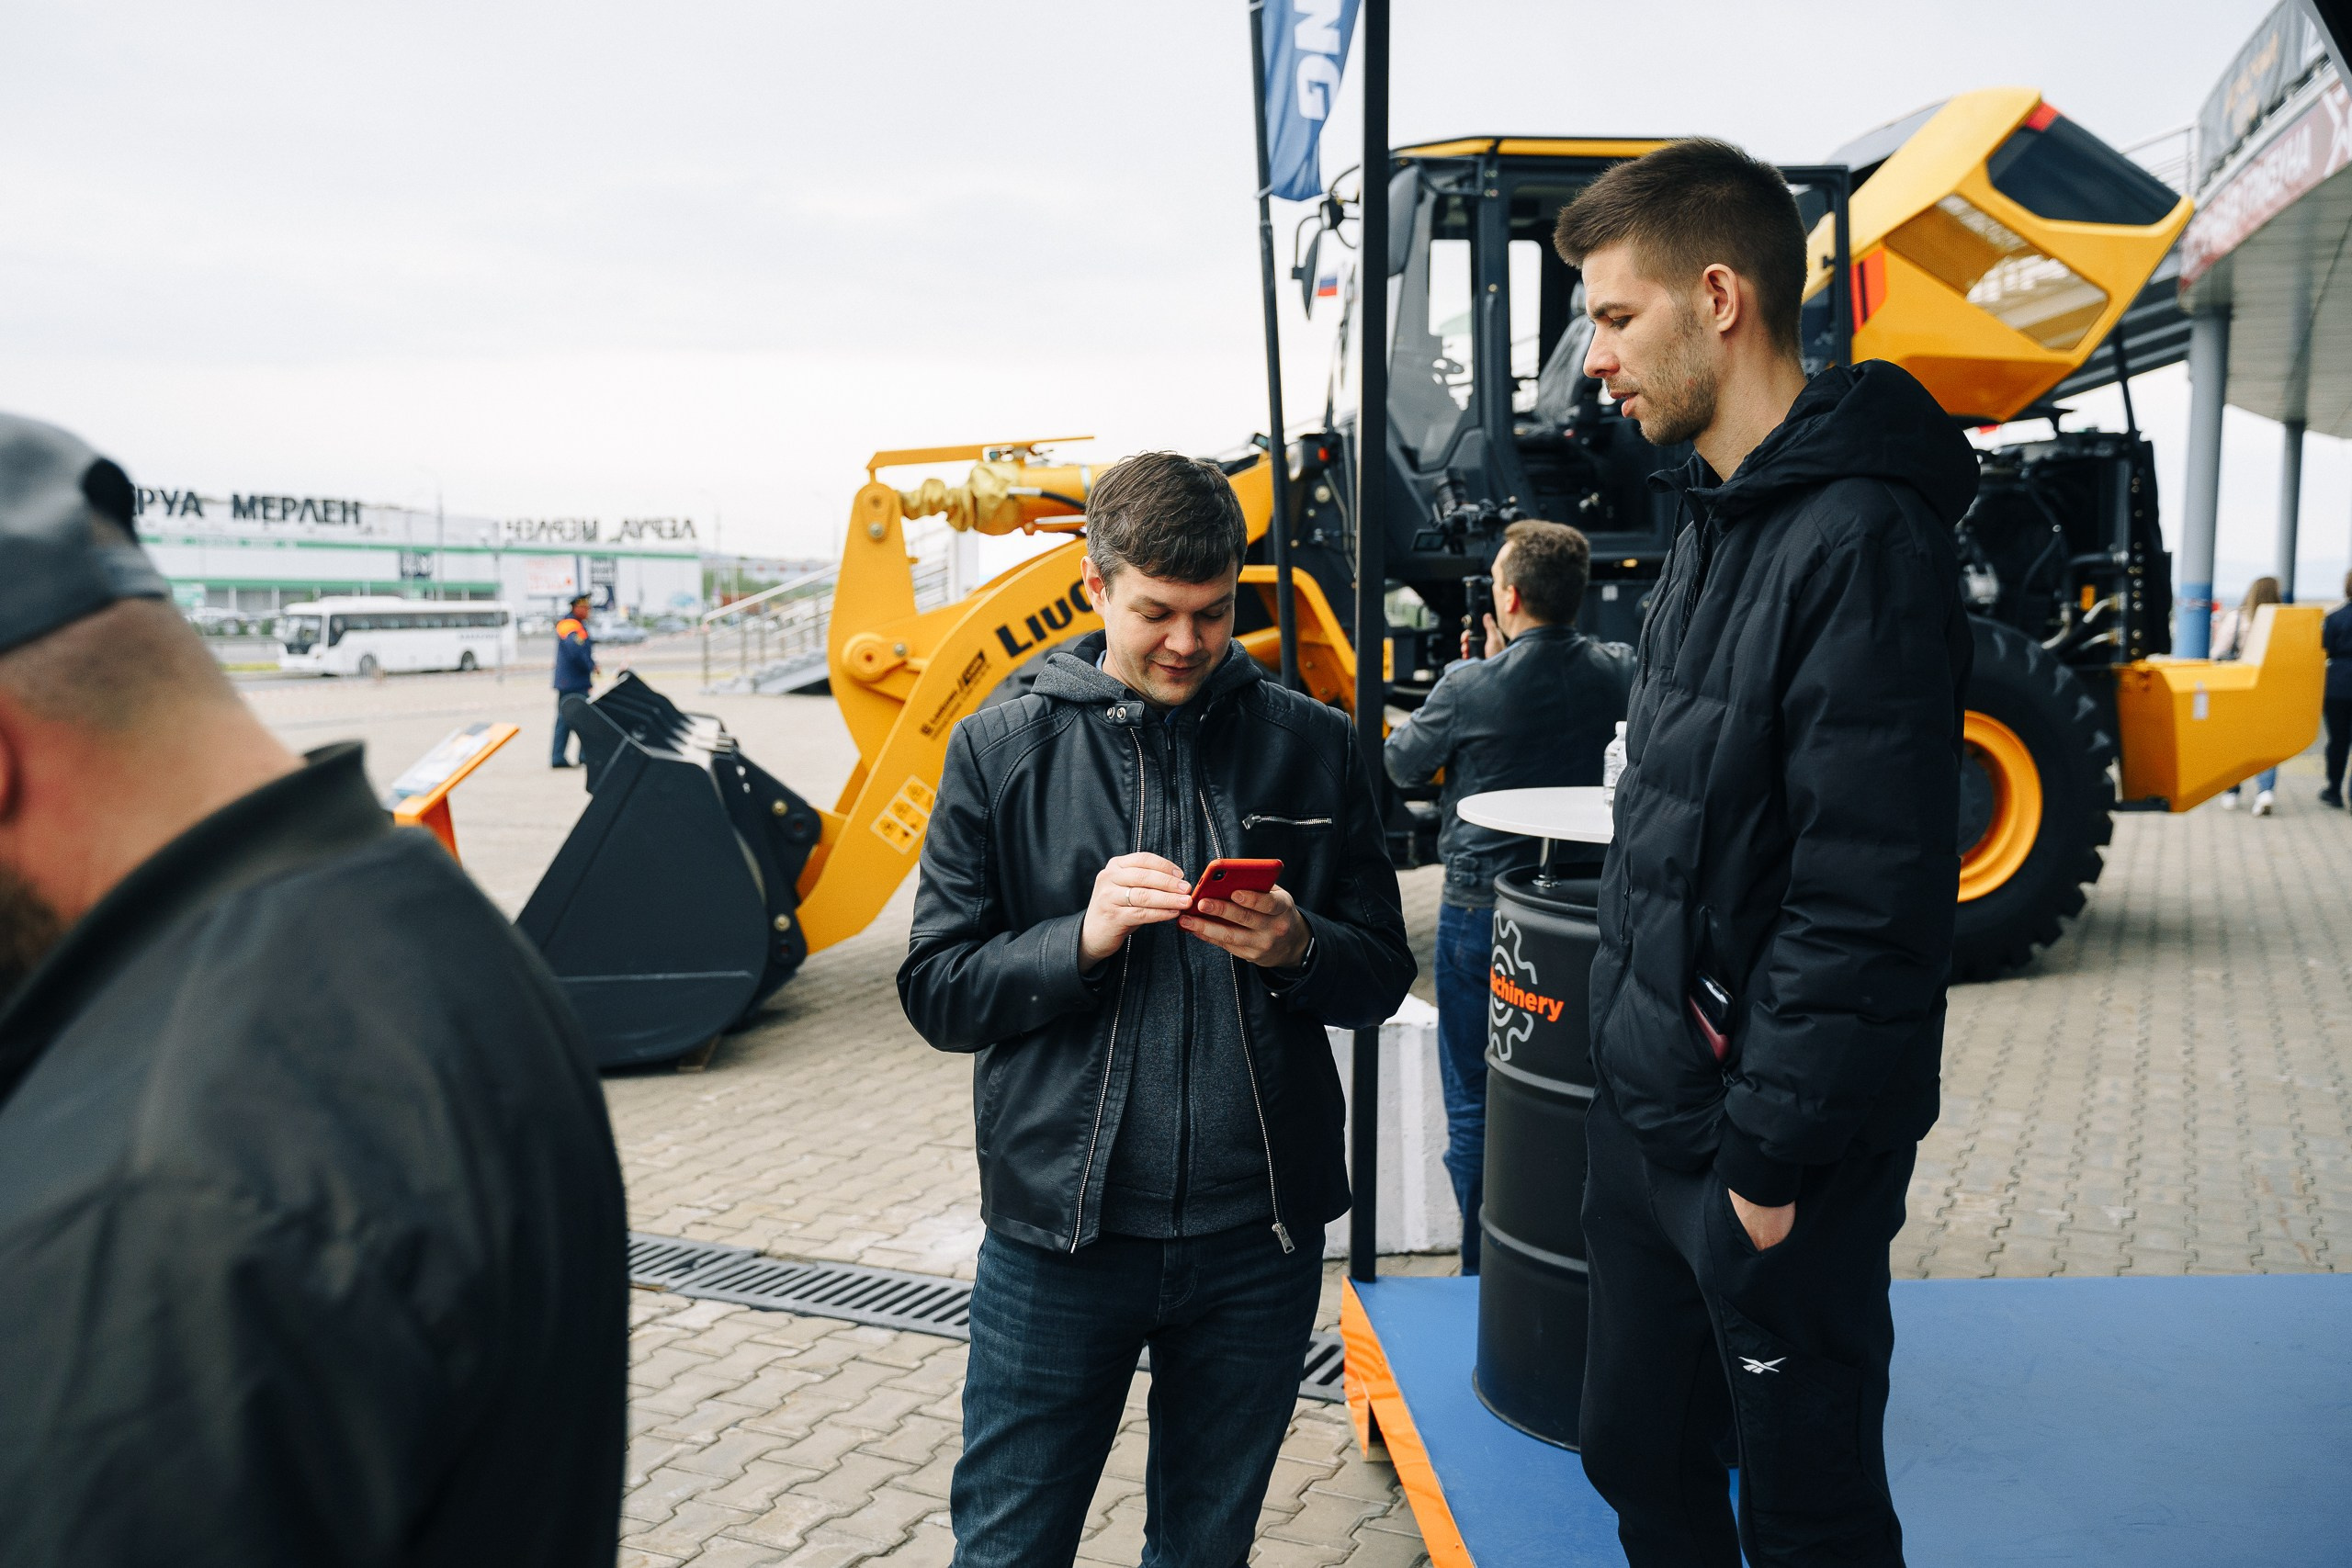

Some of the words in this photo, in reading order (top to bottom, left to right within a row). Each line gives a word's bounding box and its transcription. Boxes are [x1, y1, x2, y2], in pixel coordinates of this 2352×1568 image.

[1294, 0, 1341, 121] NG
[135, 488, 204, 517] РУА
[232, 493, 360, 525] МЕРЛЕН
